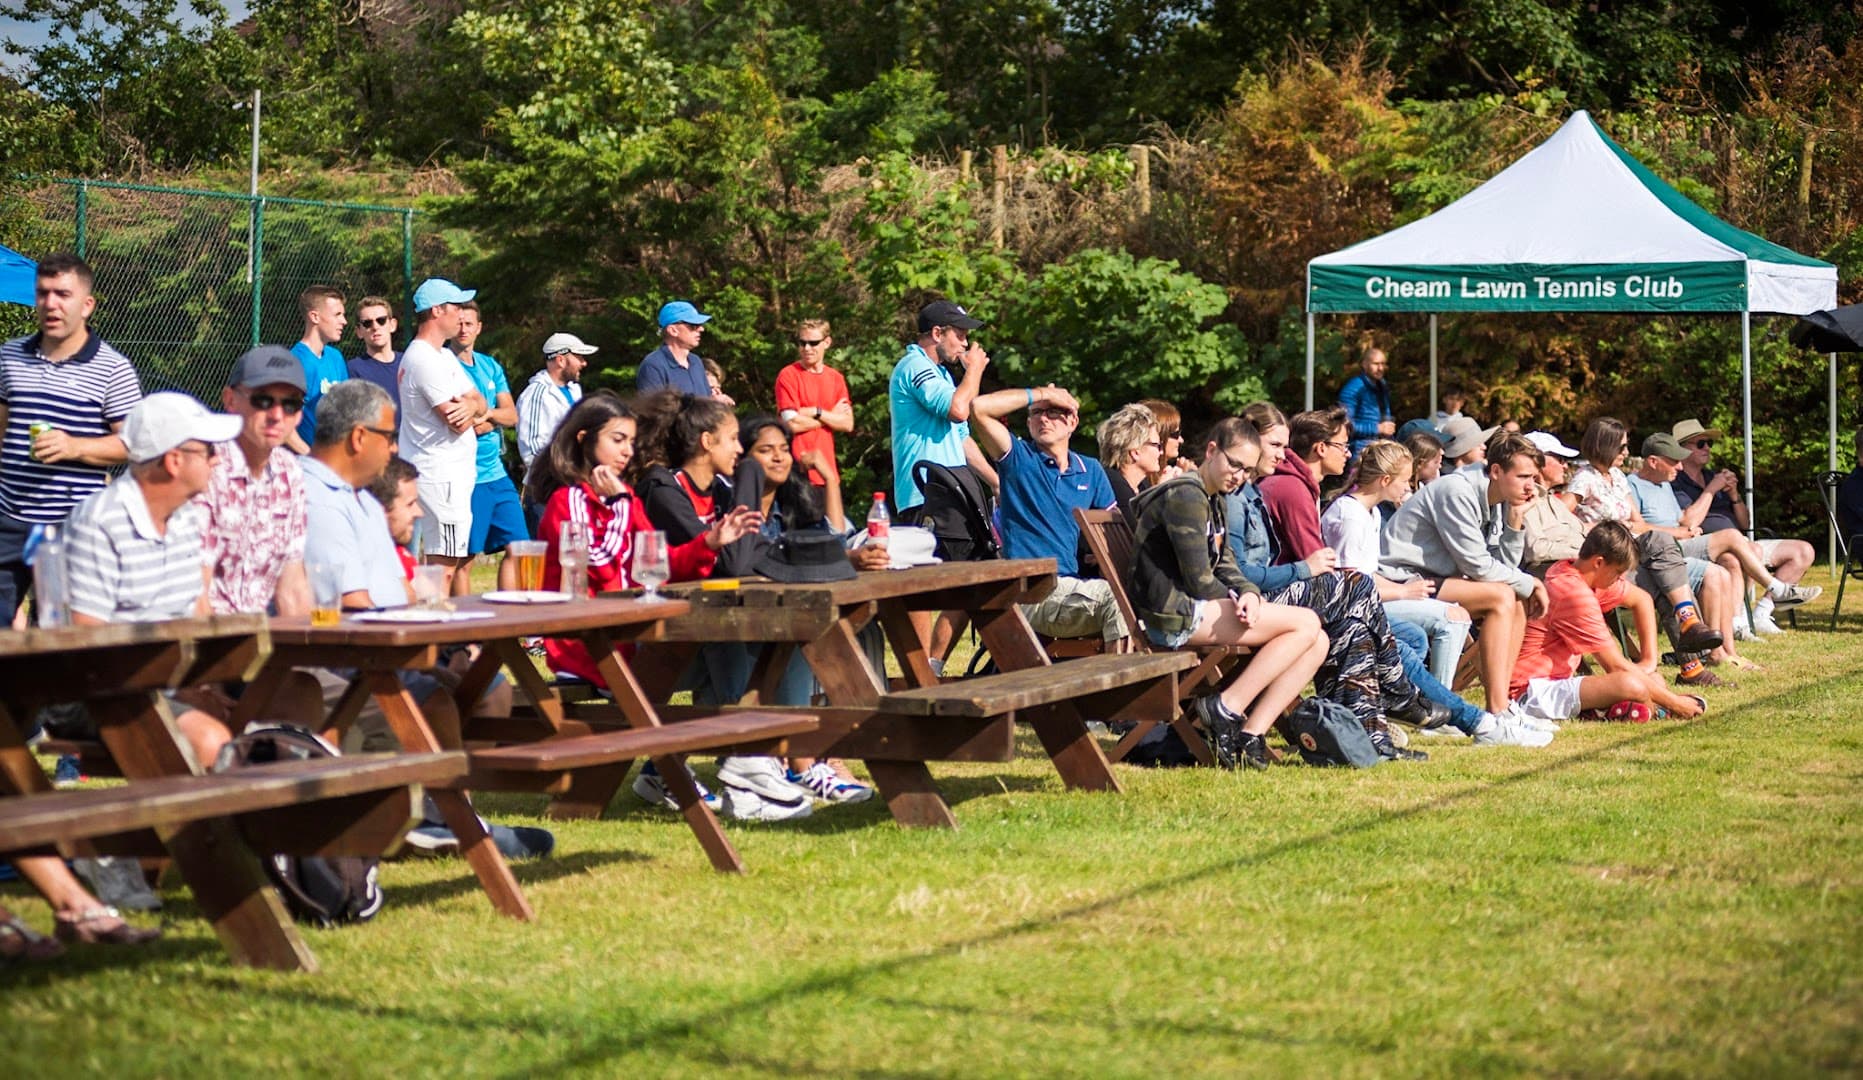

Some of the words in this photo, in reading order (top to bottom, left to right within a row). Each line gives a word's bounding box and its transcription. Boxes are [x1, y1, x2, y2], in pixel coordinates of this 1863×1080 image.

[1365, 276, 1451, 298] Cheam
[1460, 276, 1527, 299] Lawn
[1533, 276, 1617, 299] Tennis
[1624, 275, 1684, 298] Club
